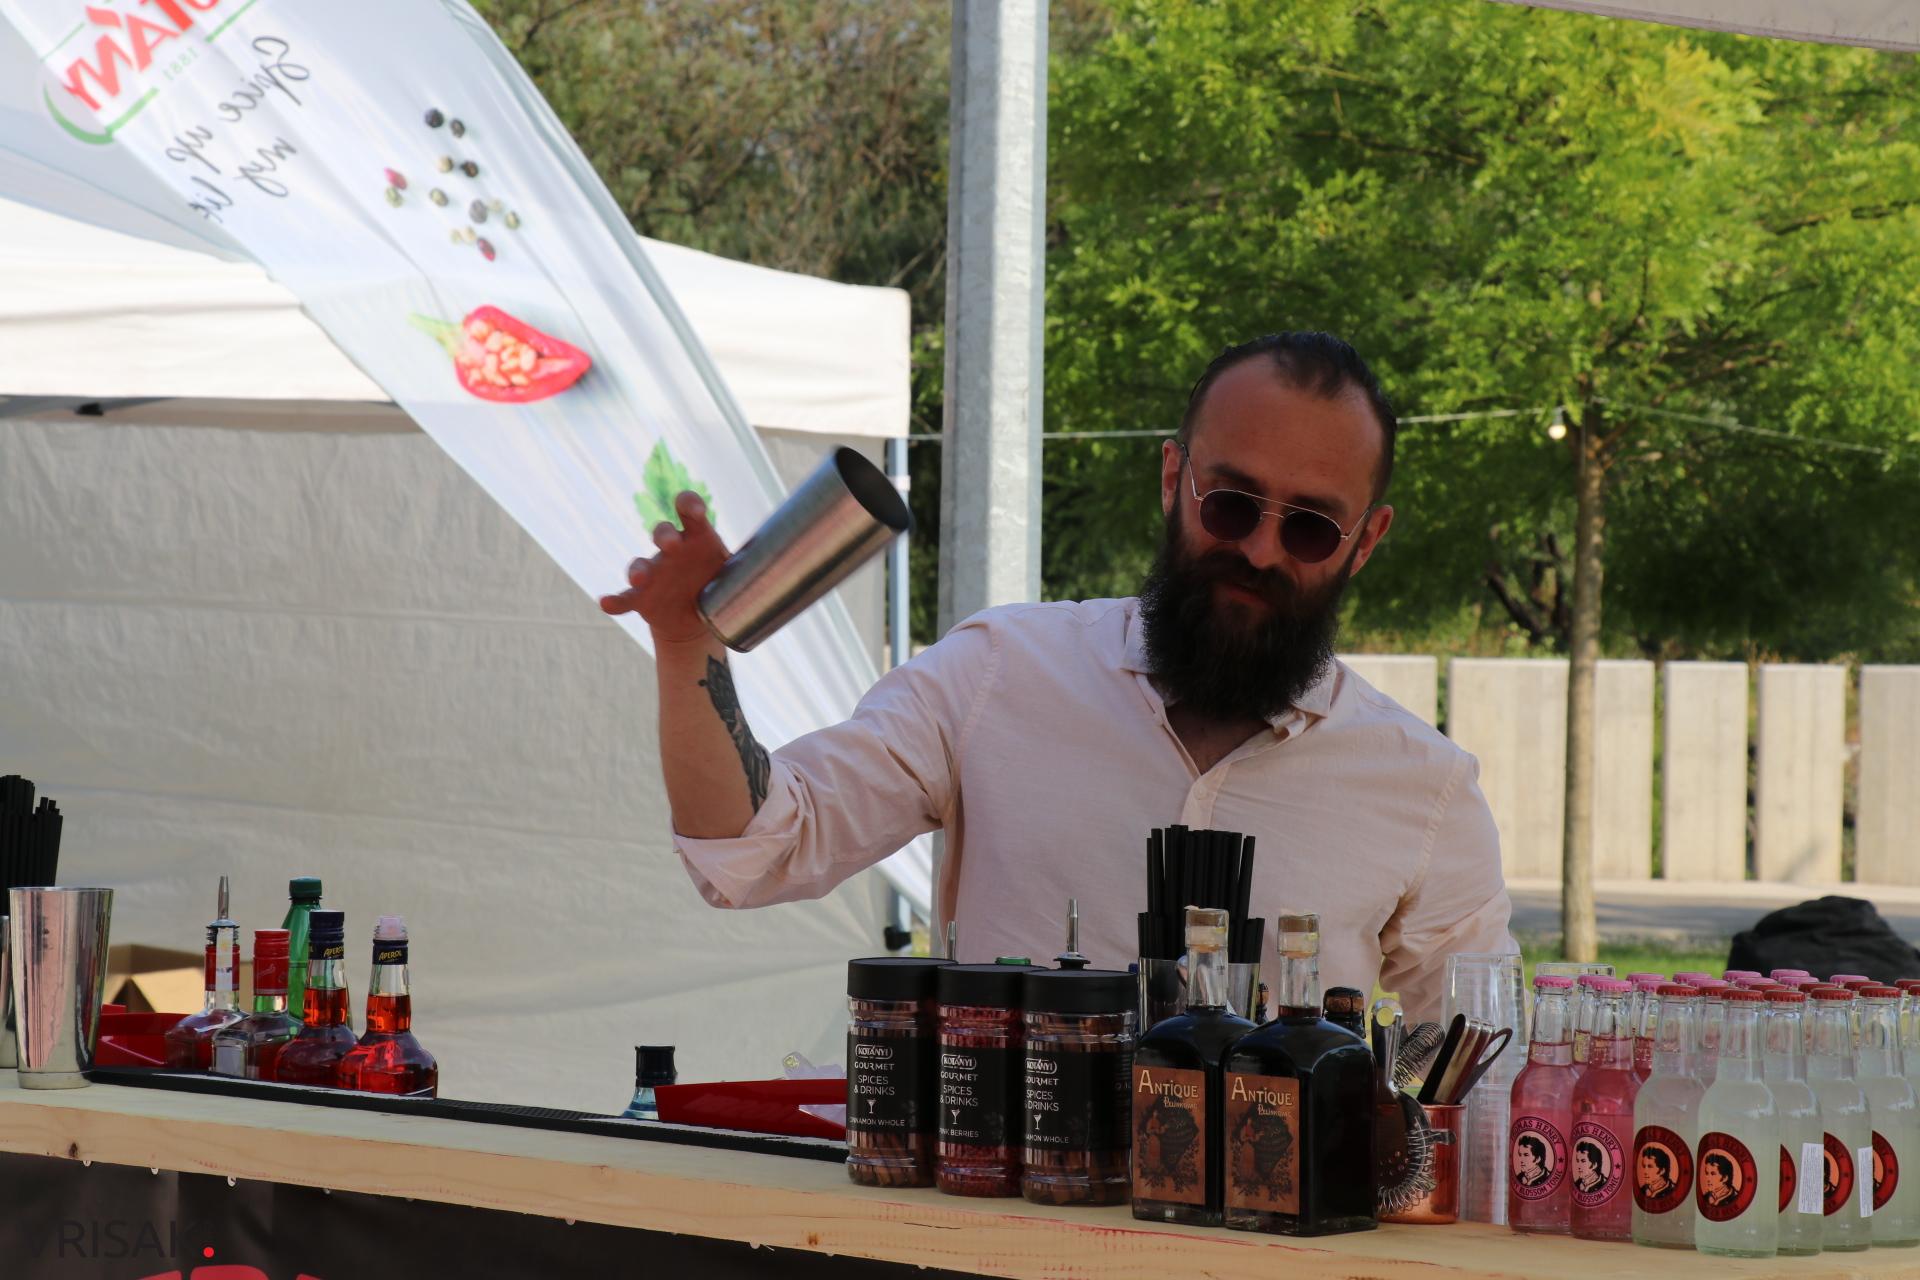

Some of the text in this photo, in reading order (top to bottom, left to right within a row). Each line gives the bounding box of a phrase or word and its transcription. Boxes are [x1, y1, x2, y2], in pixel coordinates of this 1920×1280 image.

[854, 1061, 895, 1071] GOURMET
[858, 1075, 889, 1085] SPICES
[940, 1071, 979, 1082] GOURMET
[1138, 1069, 1199, 1098] ANTIQUE
[860, 1085, 896, 1096] DRINKS
[943, 1084, 973, 1096] SPICES
[1026, 1089, 1053, 1100] SPICES
[1231, 1076, 1293, 1106] ANTIQUE
[945, 1095, 979, 1107] DRINKS
[1027, 1100, 1060, 1111] DRINKS
[878, 1119, 905, 1127] WHOLE
[950, 1128, 980, 1138] BERRIES
[1535, 1121, 1562, 1145] HENRY
[1591, 1126, 1619, 1152] HENRY
[1547, 1169, 1563, 1188] TONIC
[1604, 1174, 1620, 1195] TONIC
